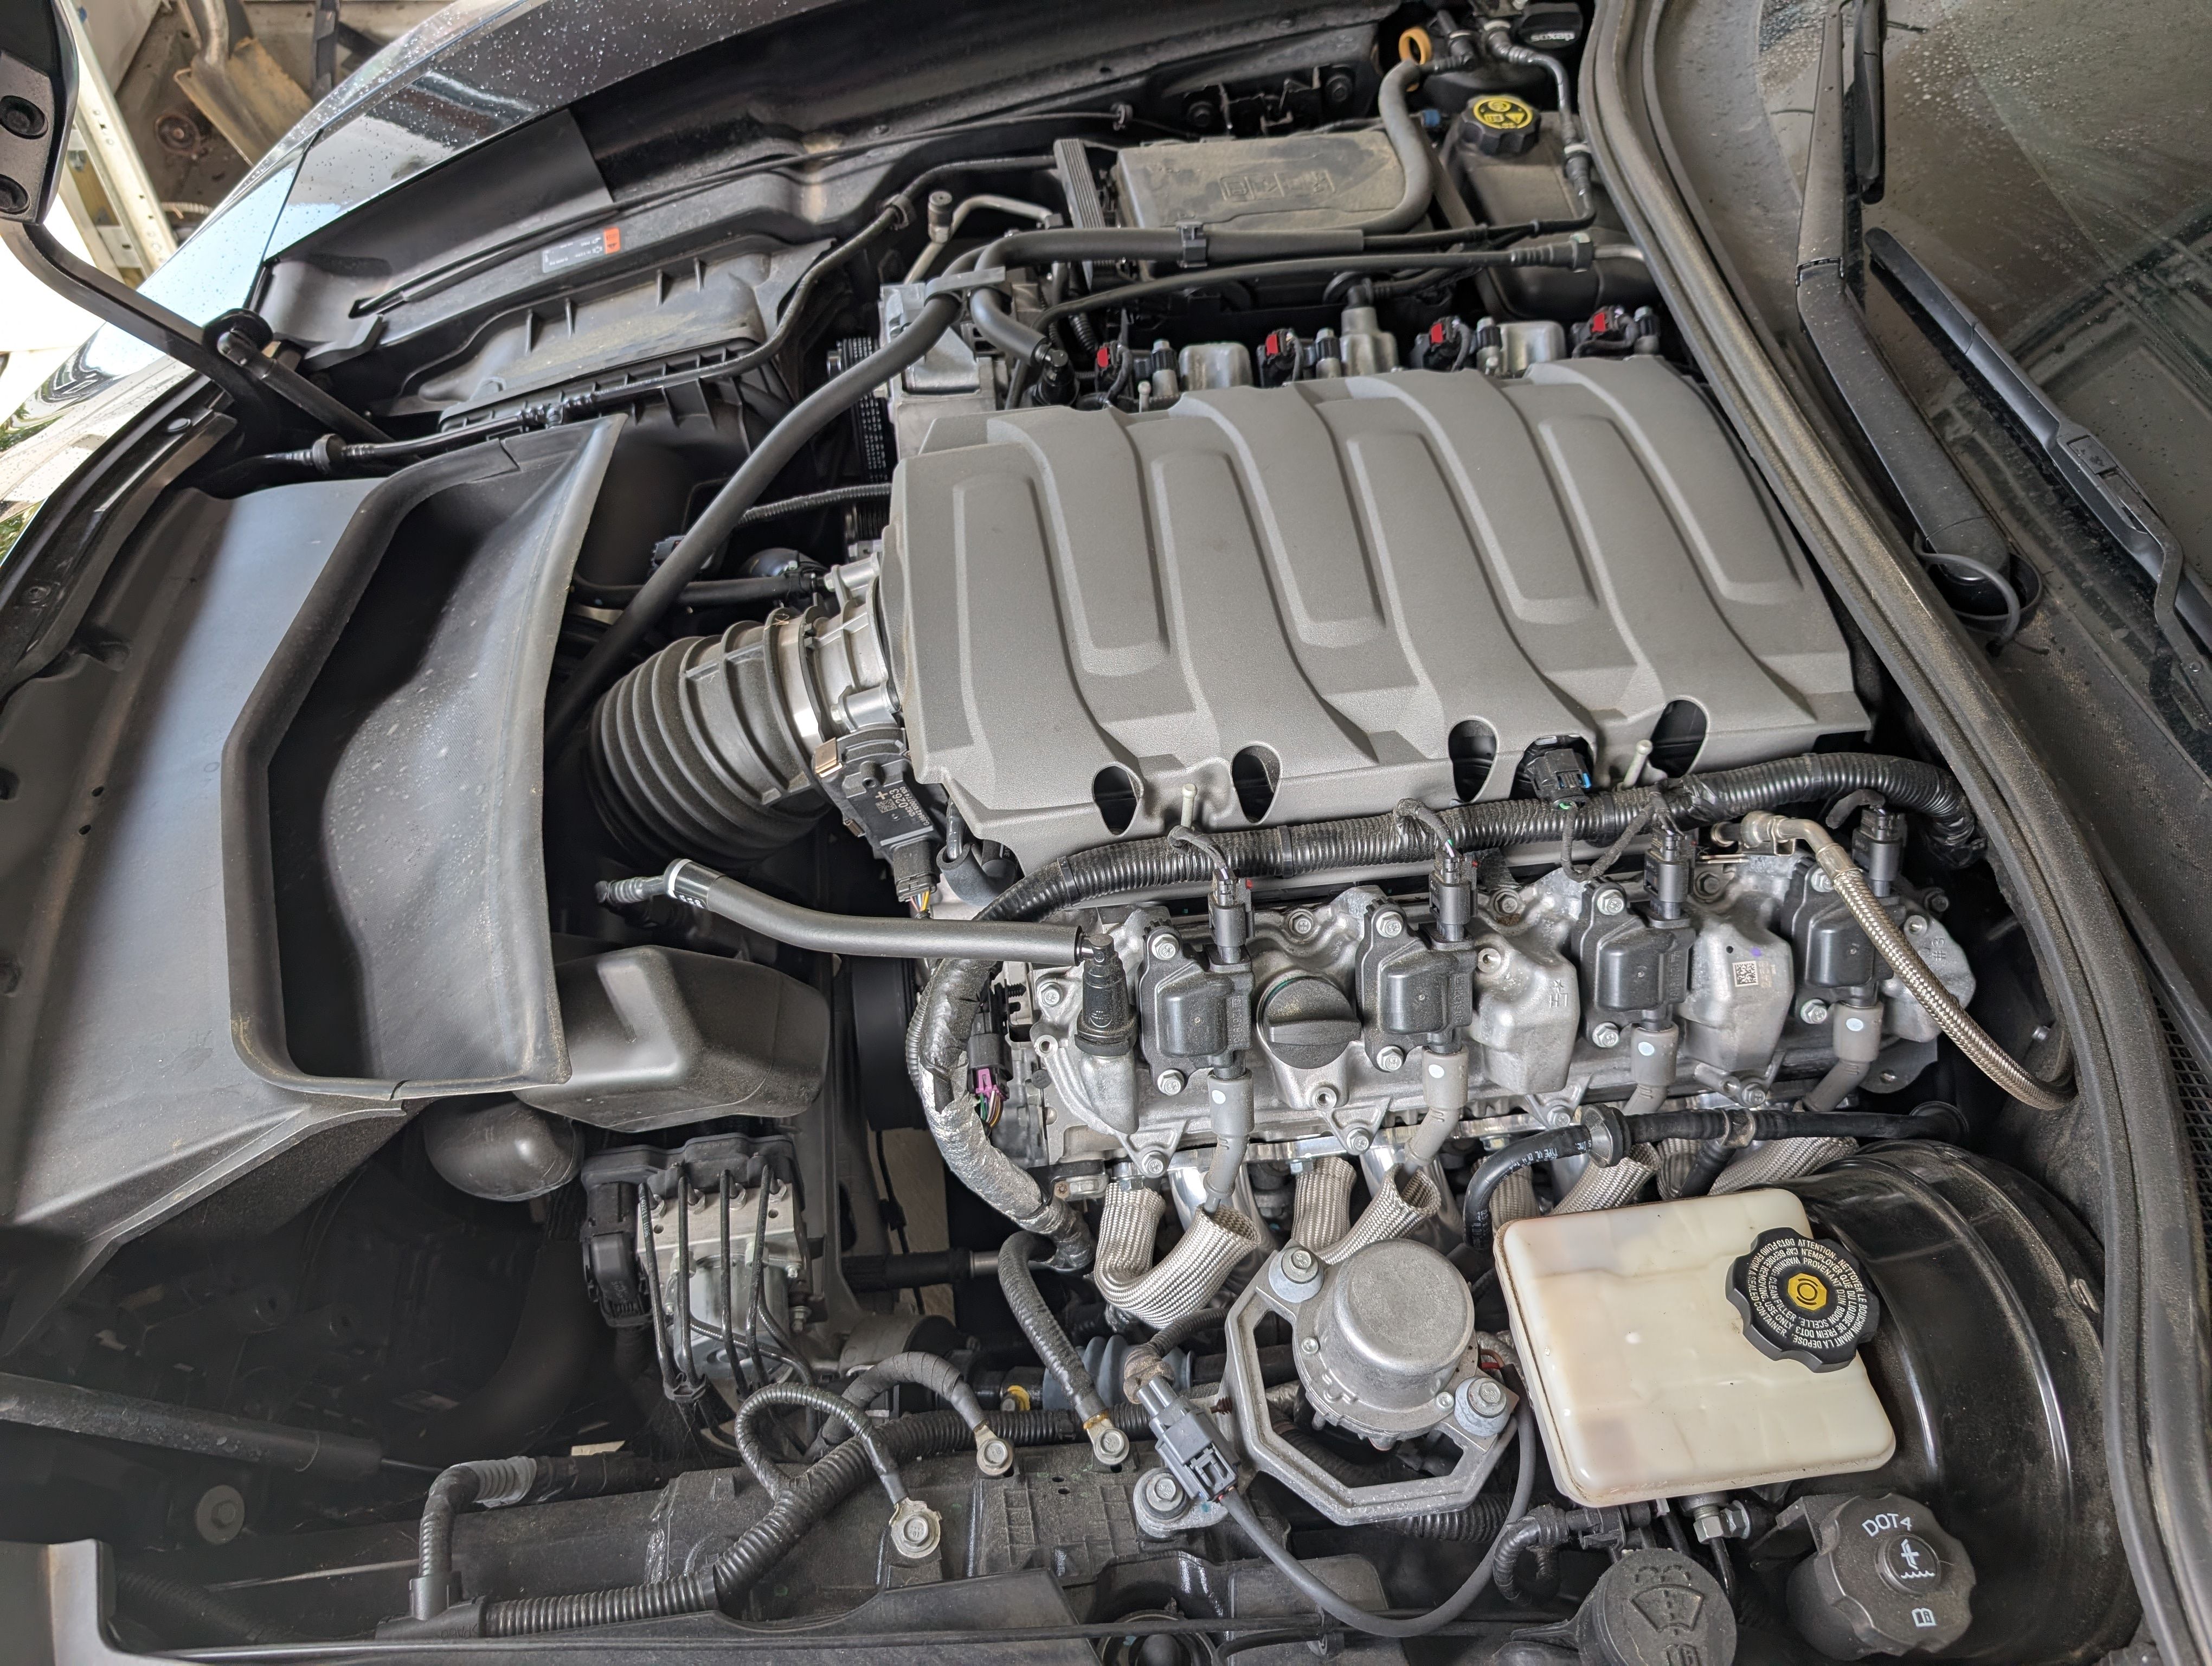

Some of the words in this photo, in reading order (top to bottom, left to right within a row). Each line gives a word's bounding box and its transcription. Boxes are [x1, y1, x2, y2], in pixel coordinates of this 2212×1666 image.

[1530, 31, 1576, 42] dexos
[1549, 992, 1568, 1008] LH
[1760, 1241, 1779, 1256] FLUID
[1776, 1238, 1796, 1247] DOT3
[1798, 1239, 1837, 1261] ATTENTION:
[1763, 1249, 1786, 1268] BEFORE
[1785, 1247, 1798, 1255] CAP
[1749, 1252, 1765, 1272] FROM
[1771, 1256, 1801, 1276] WARNING:
[1801, 1247, 1843, 1275] N'EMPLOYER
[1803, 1257, 1842, 1287] PROVENANT
[1837, 1259, 1864, 1292] NETTOYER
[1747, 1276, 1760, 1301] SEALED
[1768, 1276, 1779, 1300] CLEAN
[1840, 1274, 1853, 1289] QUE
[1836, 1289, 1847, 1305] D'UN
[1846, 1290, 1856, 1300] DU
[1857, 1293, 1867, 1303] LE
[1764, 1301, 1779, 1316] USE
[1773, 1299, 1797, 1322] FILLER
[1827, 1305, 1846, 1324] BIDON
[1842, 1300, 1857, 1327] LIQUIDE
[1775, 1314, 1795, 1330] ONLY
[1850, 1303, 1868, 1334] BOUCHON
[1795, 1326, 1815, 1338] DOT3
[1815, 1327, 1838, 1338] FREIN
[1835, 1322, 1847, 1333] DE
[1822, 1339, 1835, 1349] LA
[1834, 1330, 1855, 1347] AVANT
[1861, 1513, 1913, 1538] DOT4
